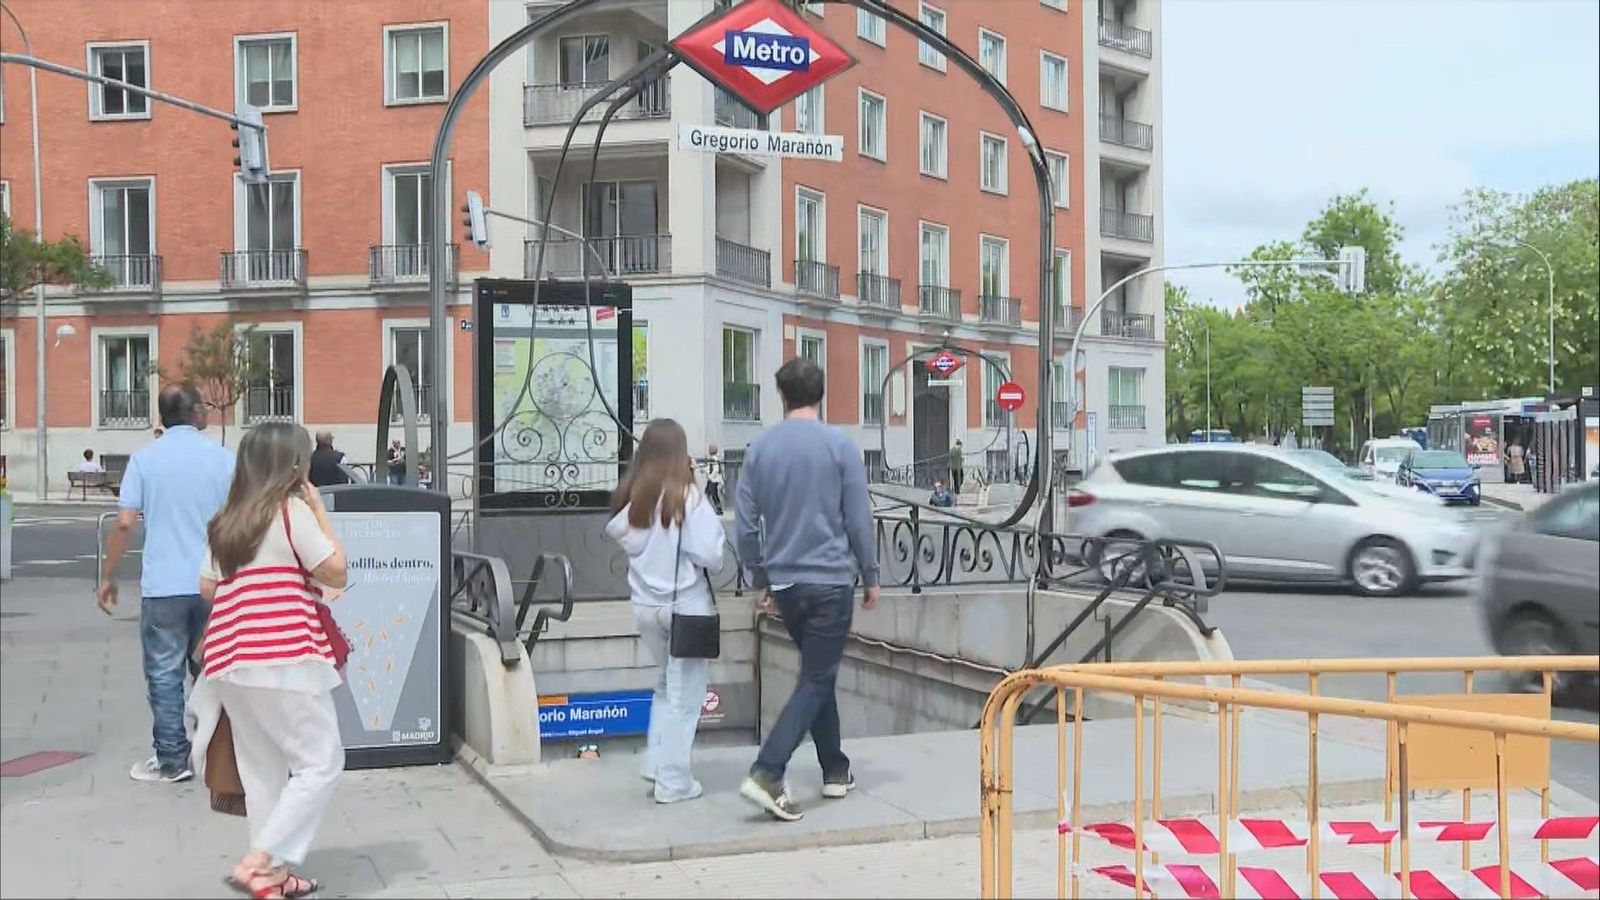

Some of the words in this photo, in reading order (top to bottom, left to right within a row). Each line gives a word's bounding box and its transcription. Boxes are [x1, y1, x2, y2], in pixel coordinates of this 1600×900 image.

[732, 35, 805, 65] Metro
[690, 130, 759, 151] Gregorio
[767, 134, 833, 156] Marañón
[569, 704, 628, 721] Marañón
[401, 731, 435, 741] MADRID
